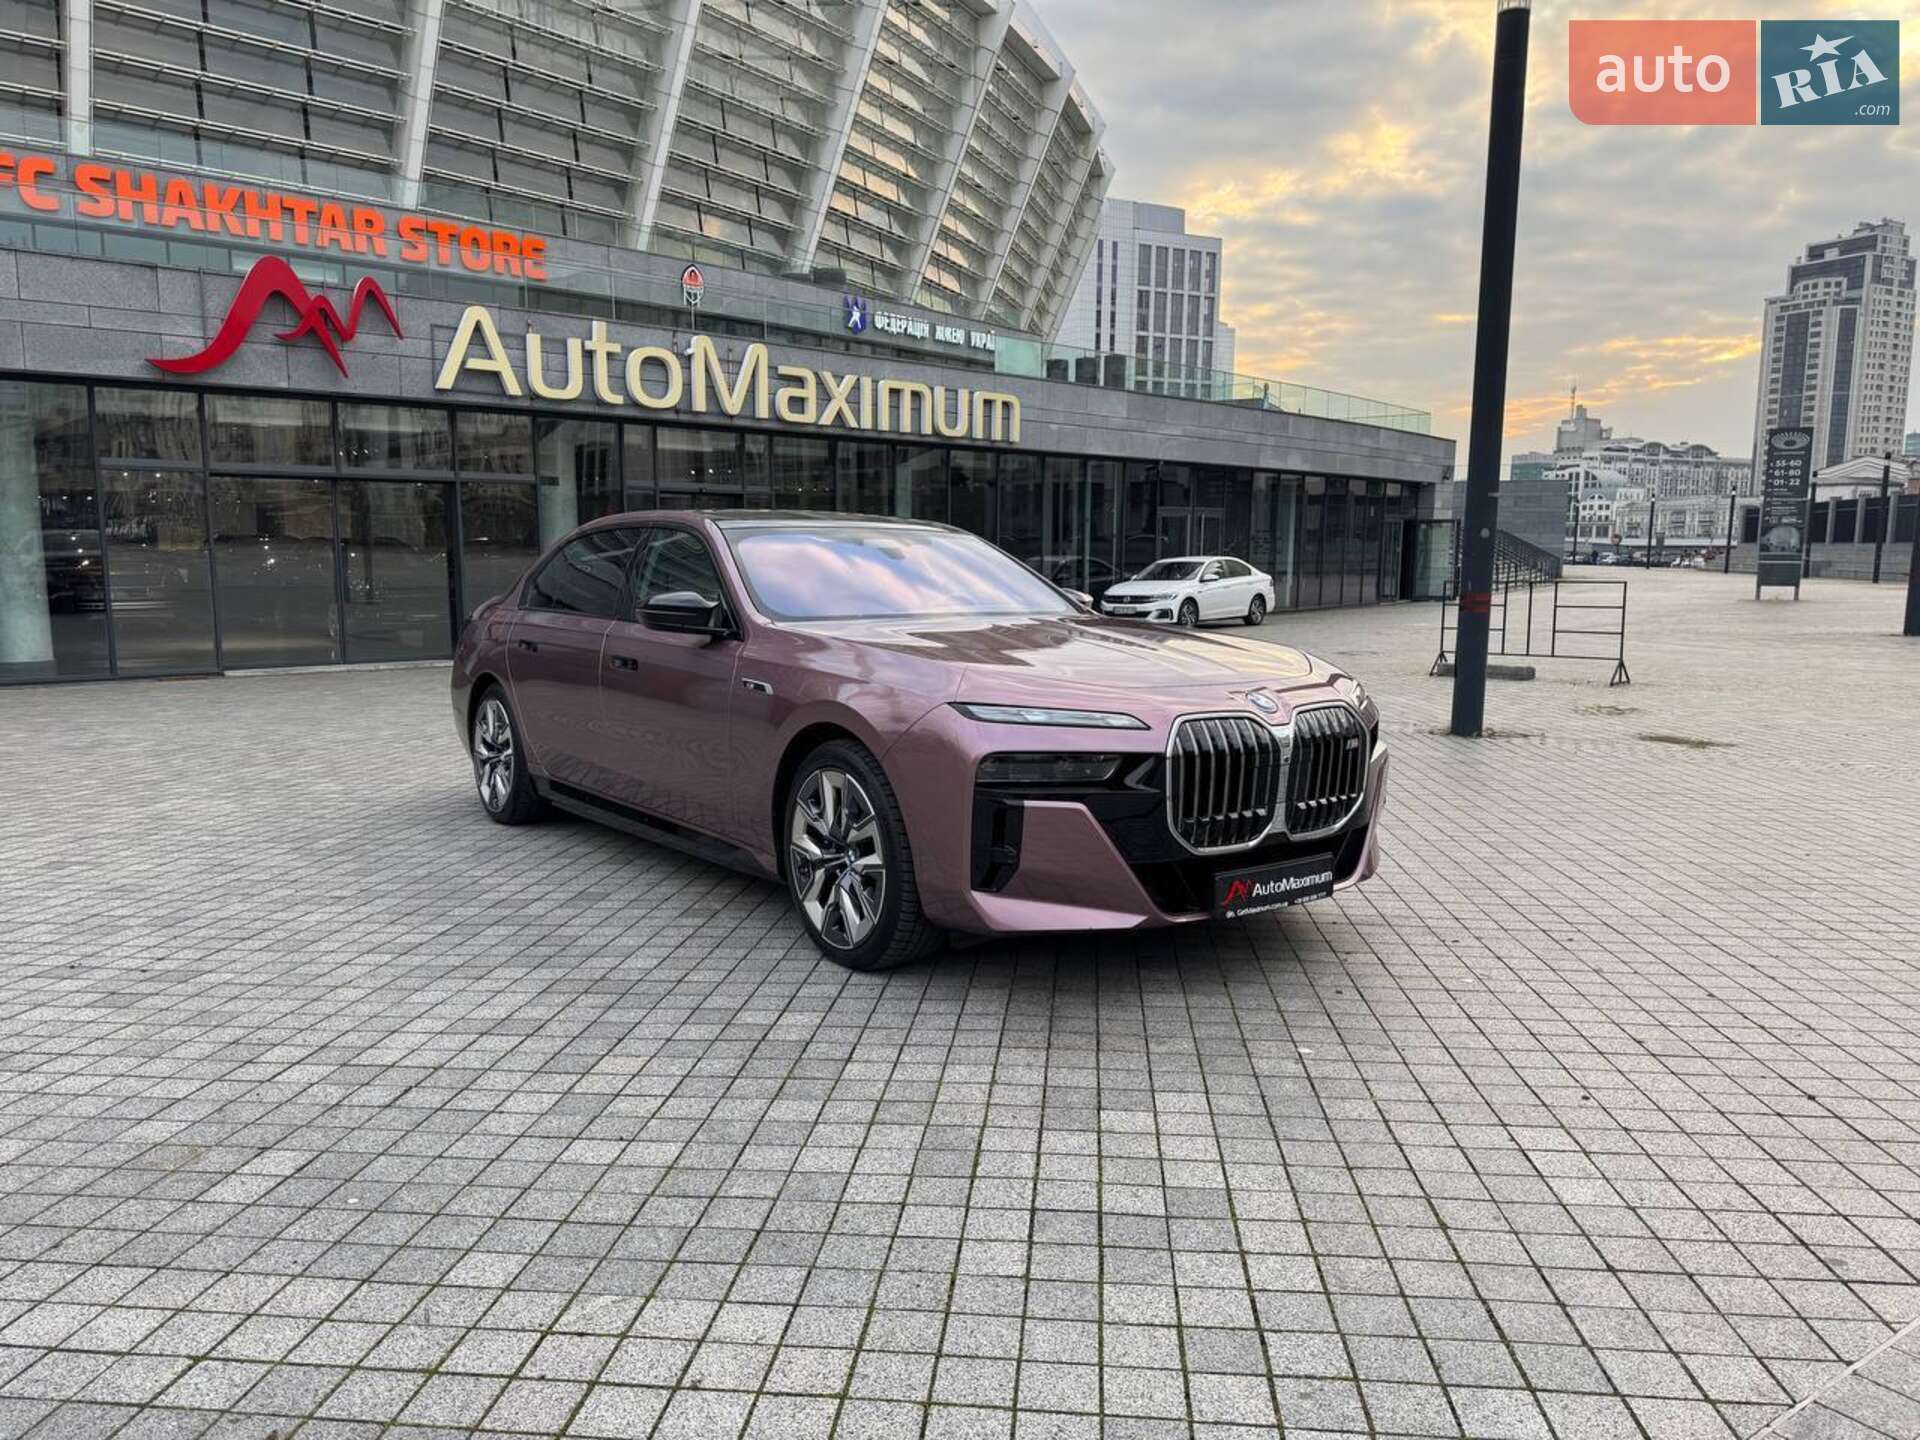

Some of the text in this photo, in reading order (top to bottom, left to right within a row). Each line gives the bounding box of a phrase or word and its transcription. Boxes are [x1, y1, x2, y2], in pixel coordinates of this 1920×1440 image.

[74, 163, 388, 257] SHAKHTAR
[398, 216, 548, 280] STORE
[434, 304, 1022, 444] AutoMaximum
